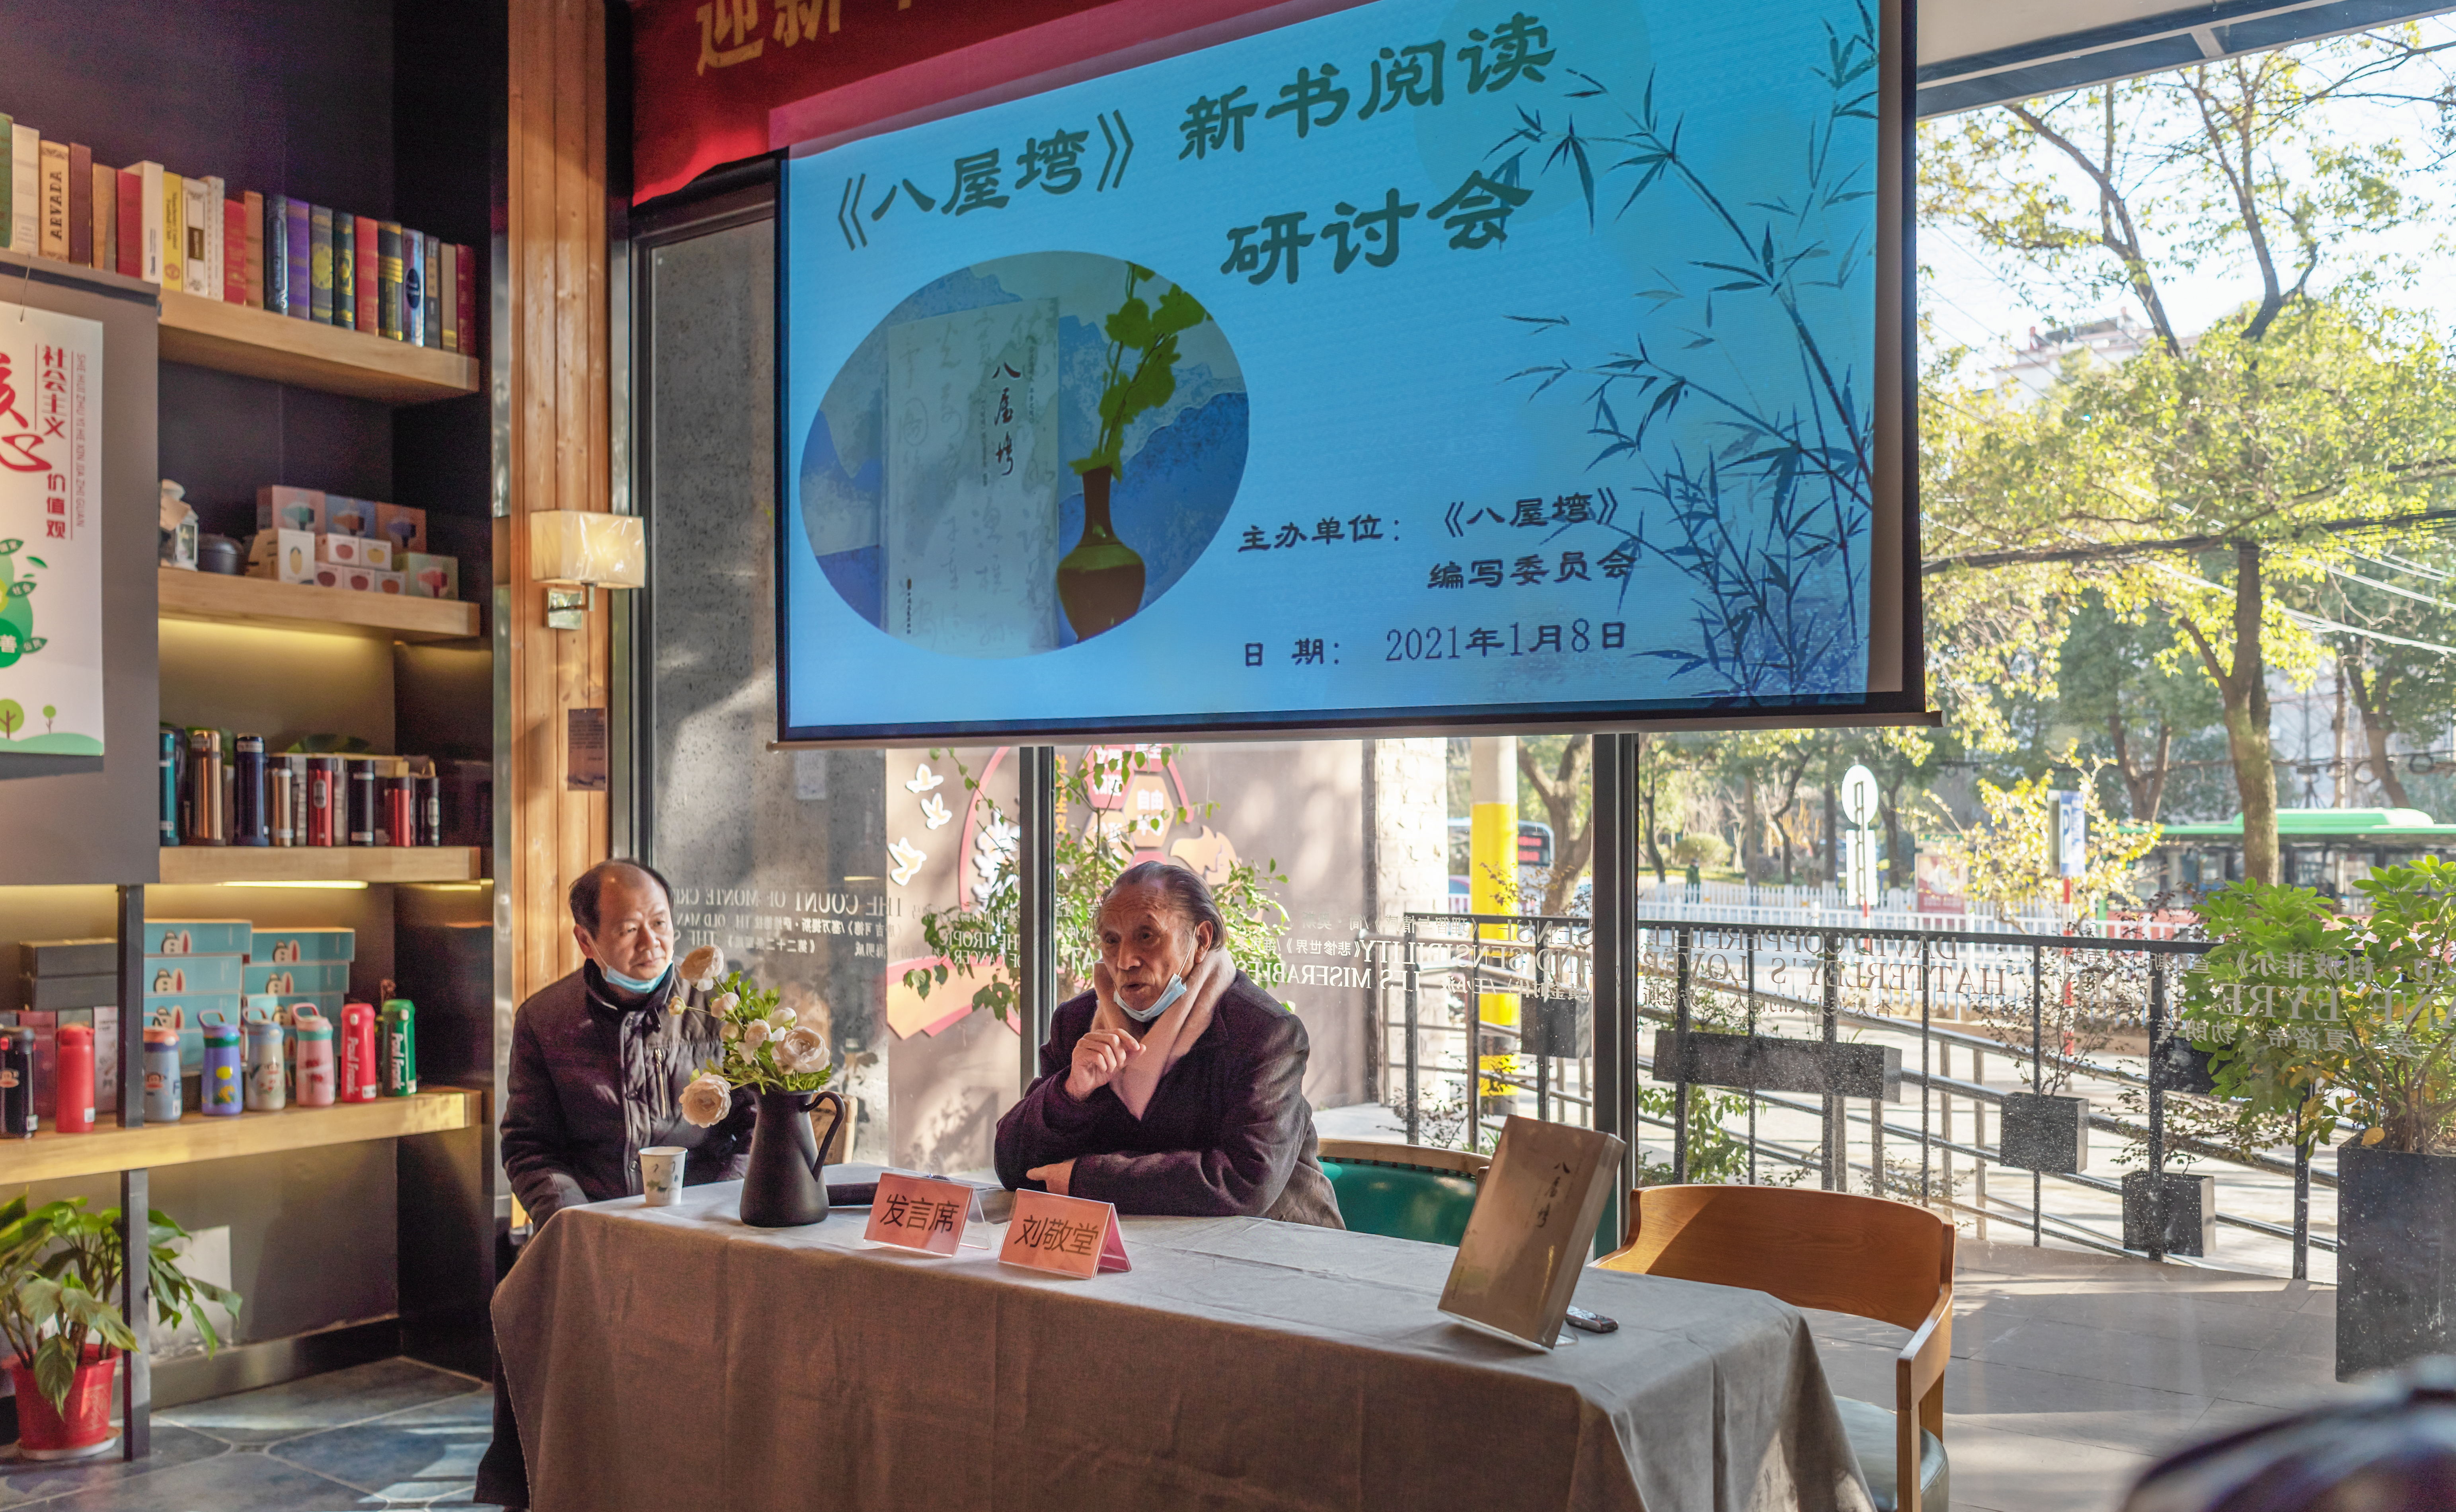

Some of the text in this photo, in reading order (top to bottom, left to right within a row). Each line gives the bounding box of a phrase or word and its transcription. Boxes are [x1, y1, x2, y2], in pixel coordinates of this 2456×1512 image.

[1178, 11, 1556, 161] 新书阅读
[1221, 170, 1534, 286] 研讨会
[42, 345, 68, 539] 社会主义 价值观
[1427, 549, 1637, 589] 编写委员会
[0, 634, 17, 654] 善
[1244, 642, 1264, 666] 日
[1385, 618, 1626, 661] 2021年1月8日
[1137, 788, 1164, 811] 自由
[879, 1194, 960, 1234] 发言席
[1014, 1215, 1099, 1256] 刘敬堂
